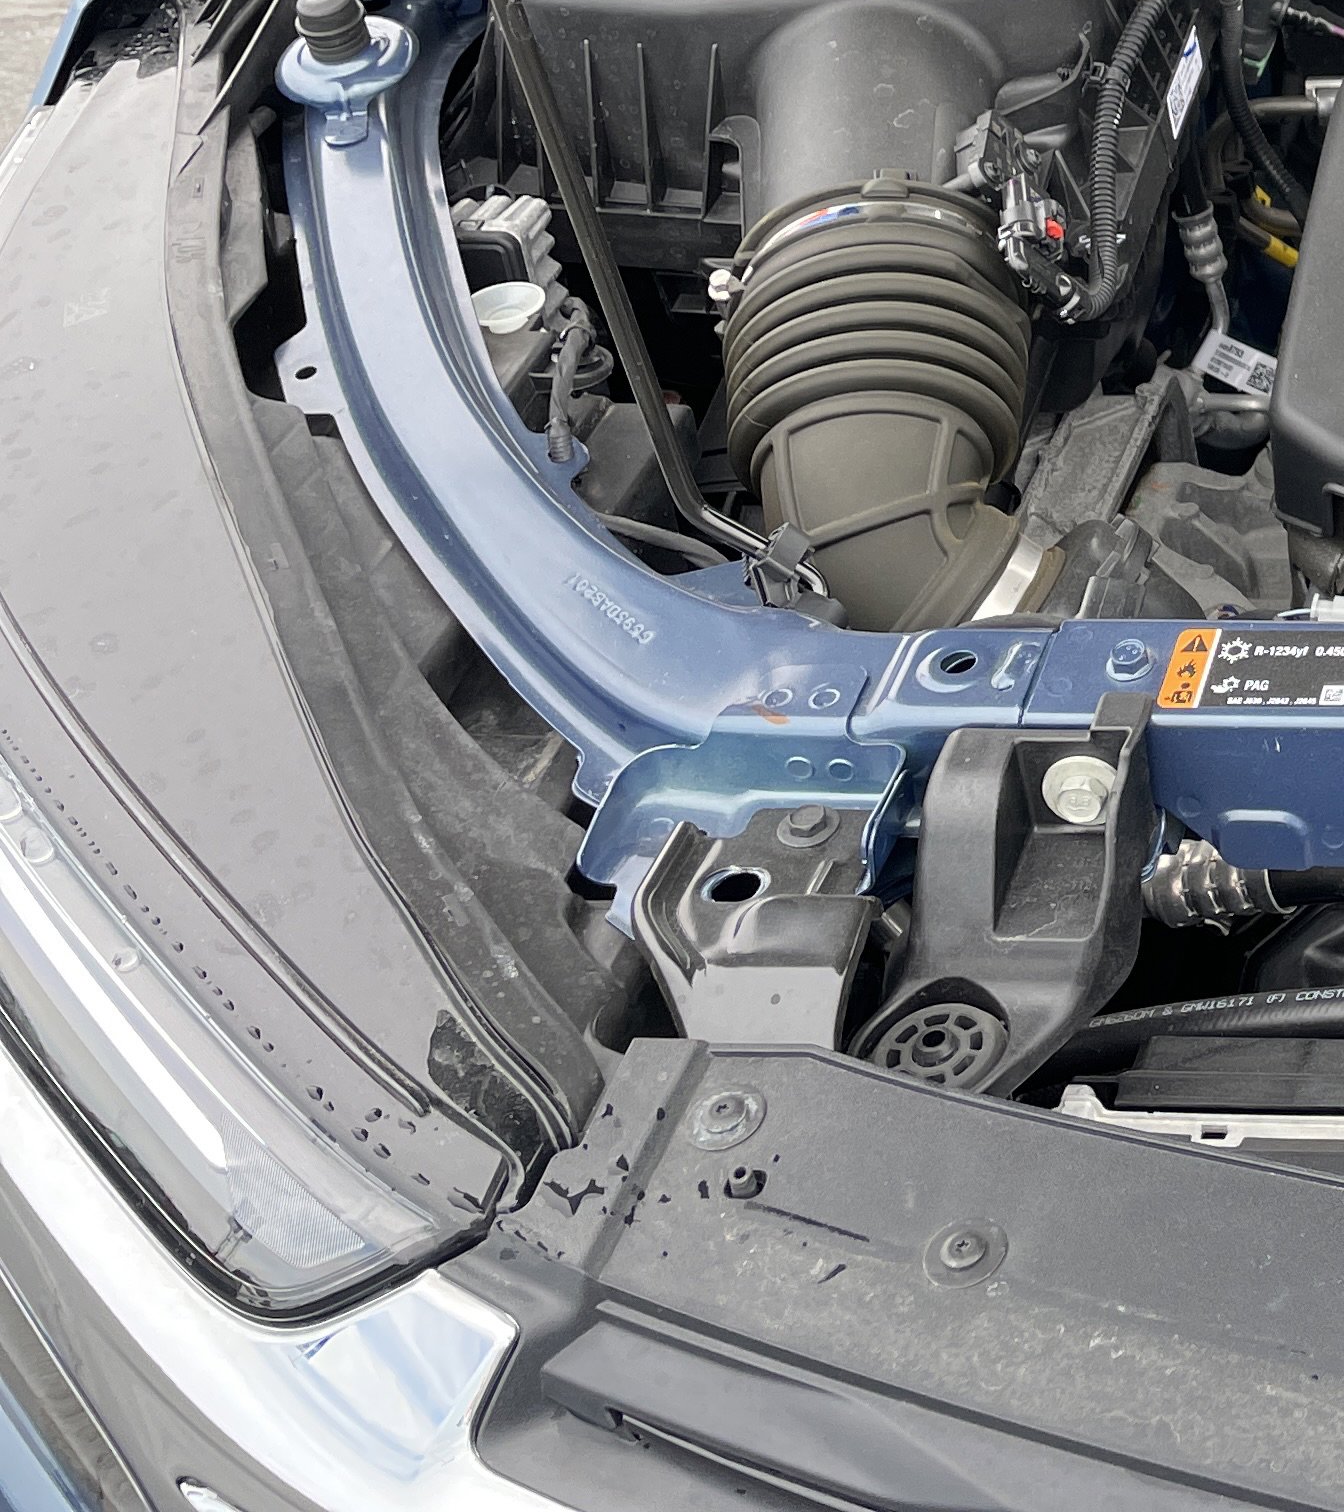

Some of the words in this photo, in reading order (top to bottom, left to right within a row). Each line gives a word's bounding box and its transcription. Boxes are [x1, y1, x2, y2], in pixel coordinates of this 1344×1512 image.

[1253, 645, 1309, 659] R-1234yf
[1243, 679, 1270, 692] PAG
[1180, 995, 1256, 1013] GMW16171
